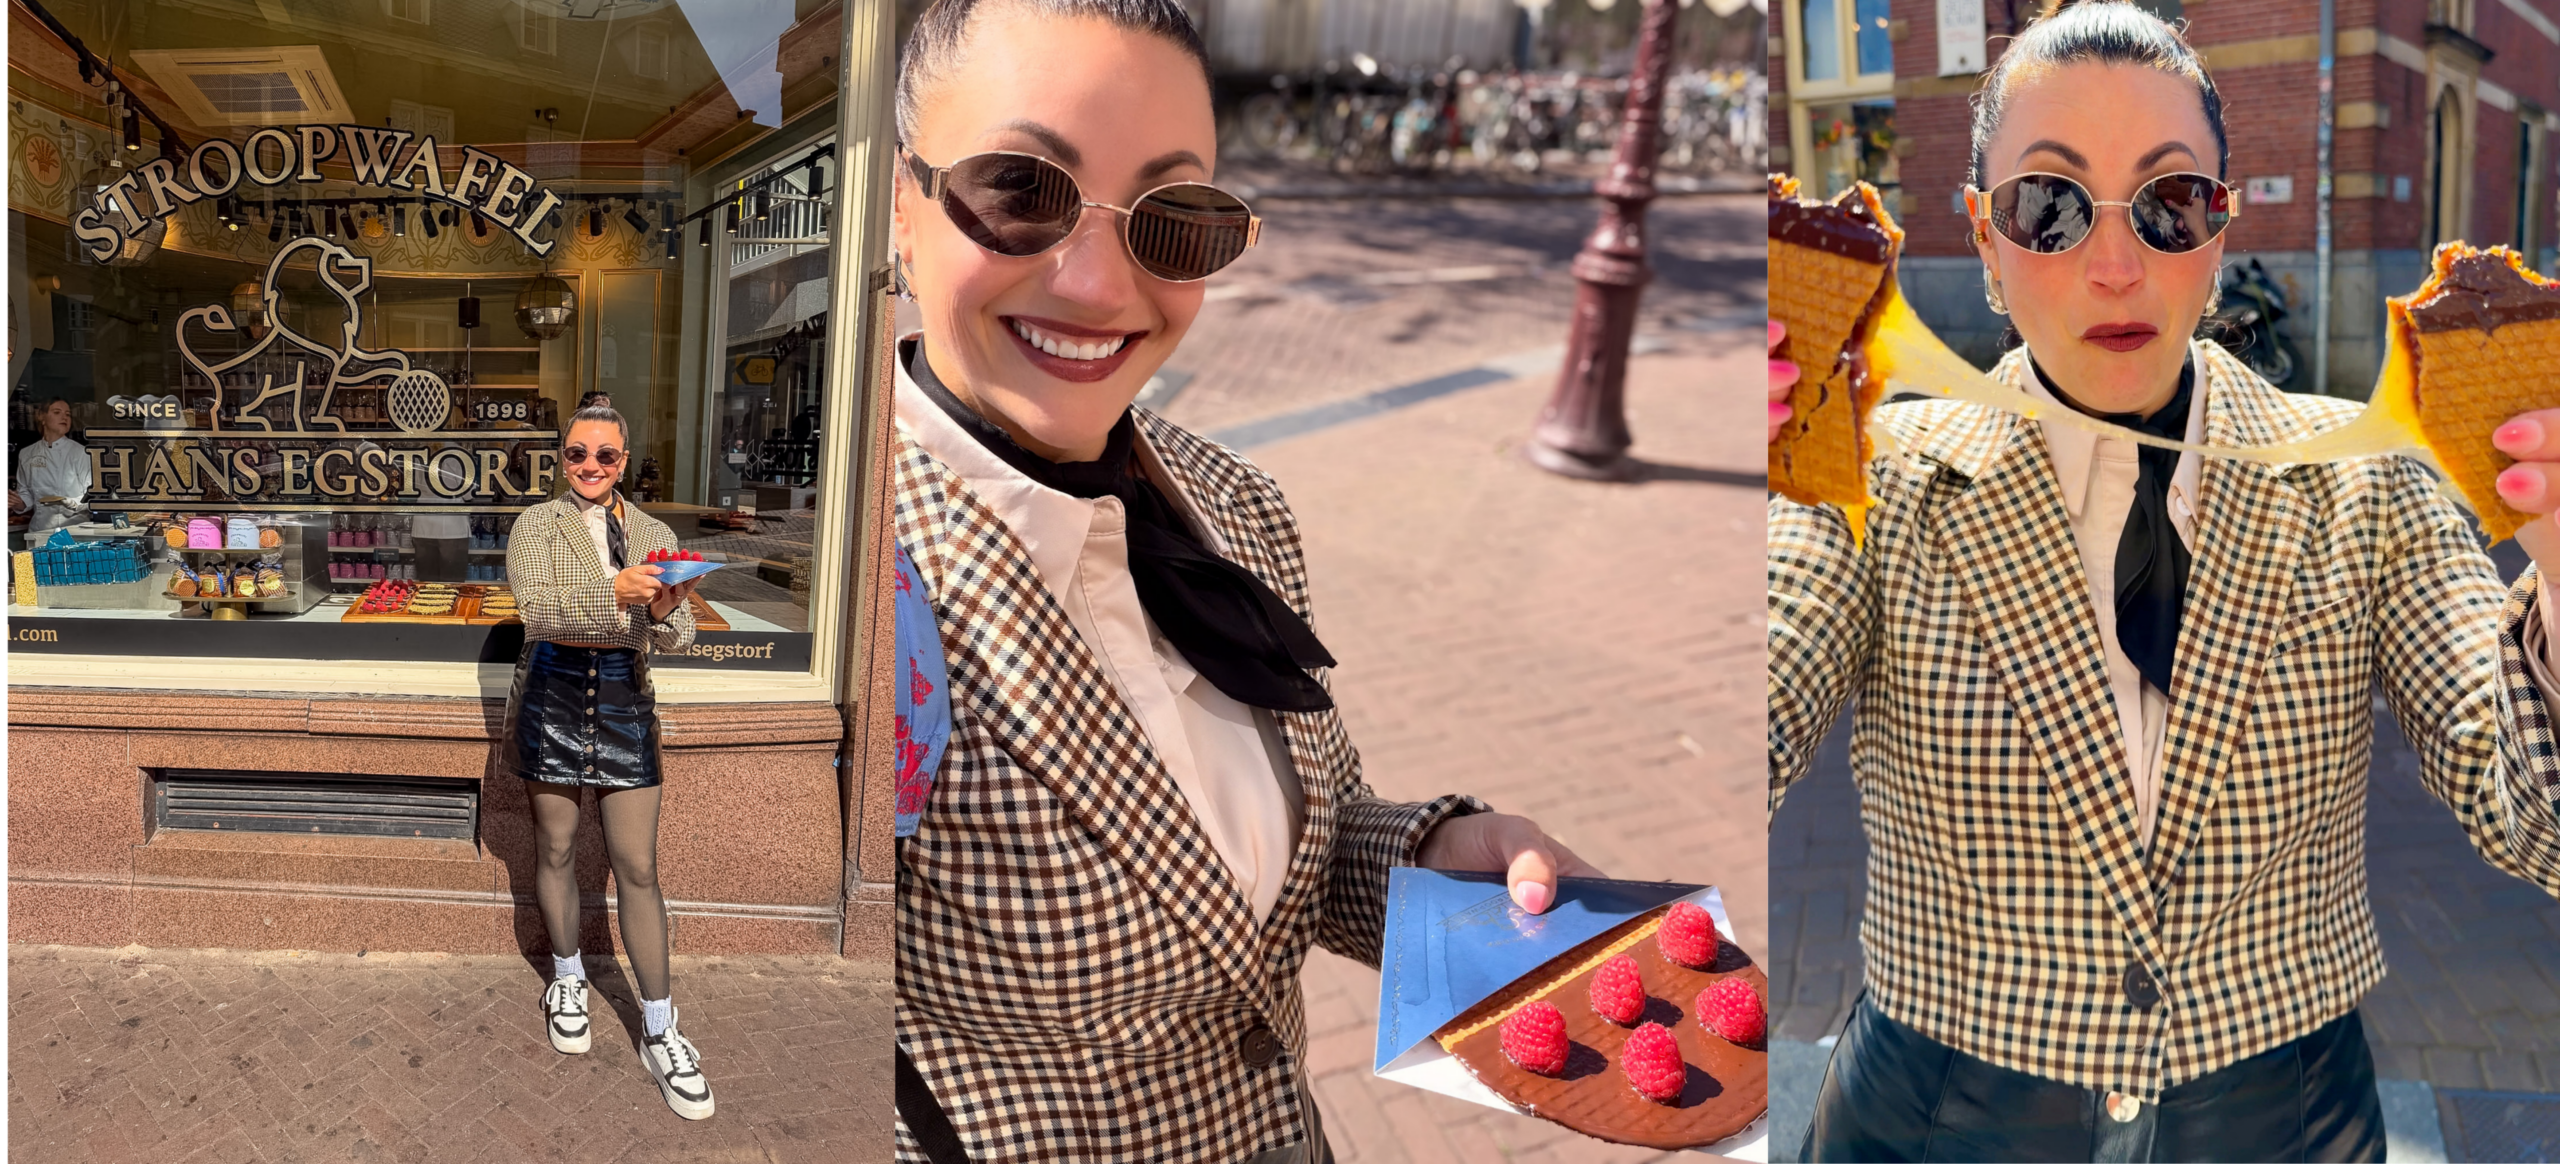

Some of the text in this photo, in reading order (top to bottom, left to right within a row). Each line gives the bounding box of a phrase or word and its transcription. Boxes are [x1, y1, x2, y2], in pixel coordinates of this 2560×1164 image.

[74, 125, 562, 257] STROOPWAFEL
[114, 402, 527, 419] SINCE 1898
[85, 448, 558, 496] HANS EGSTORF
